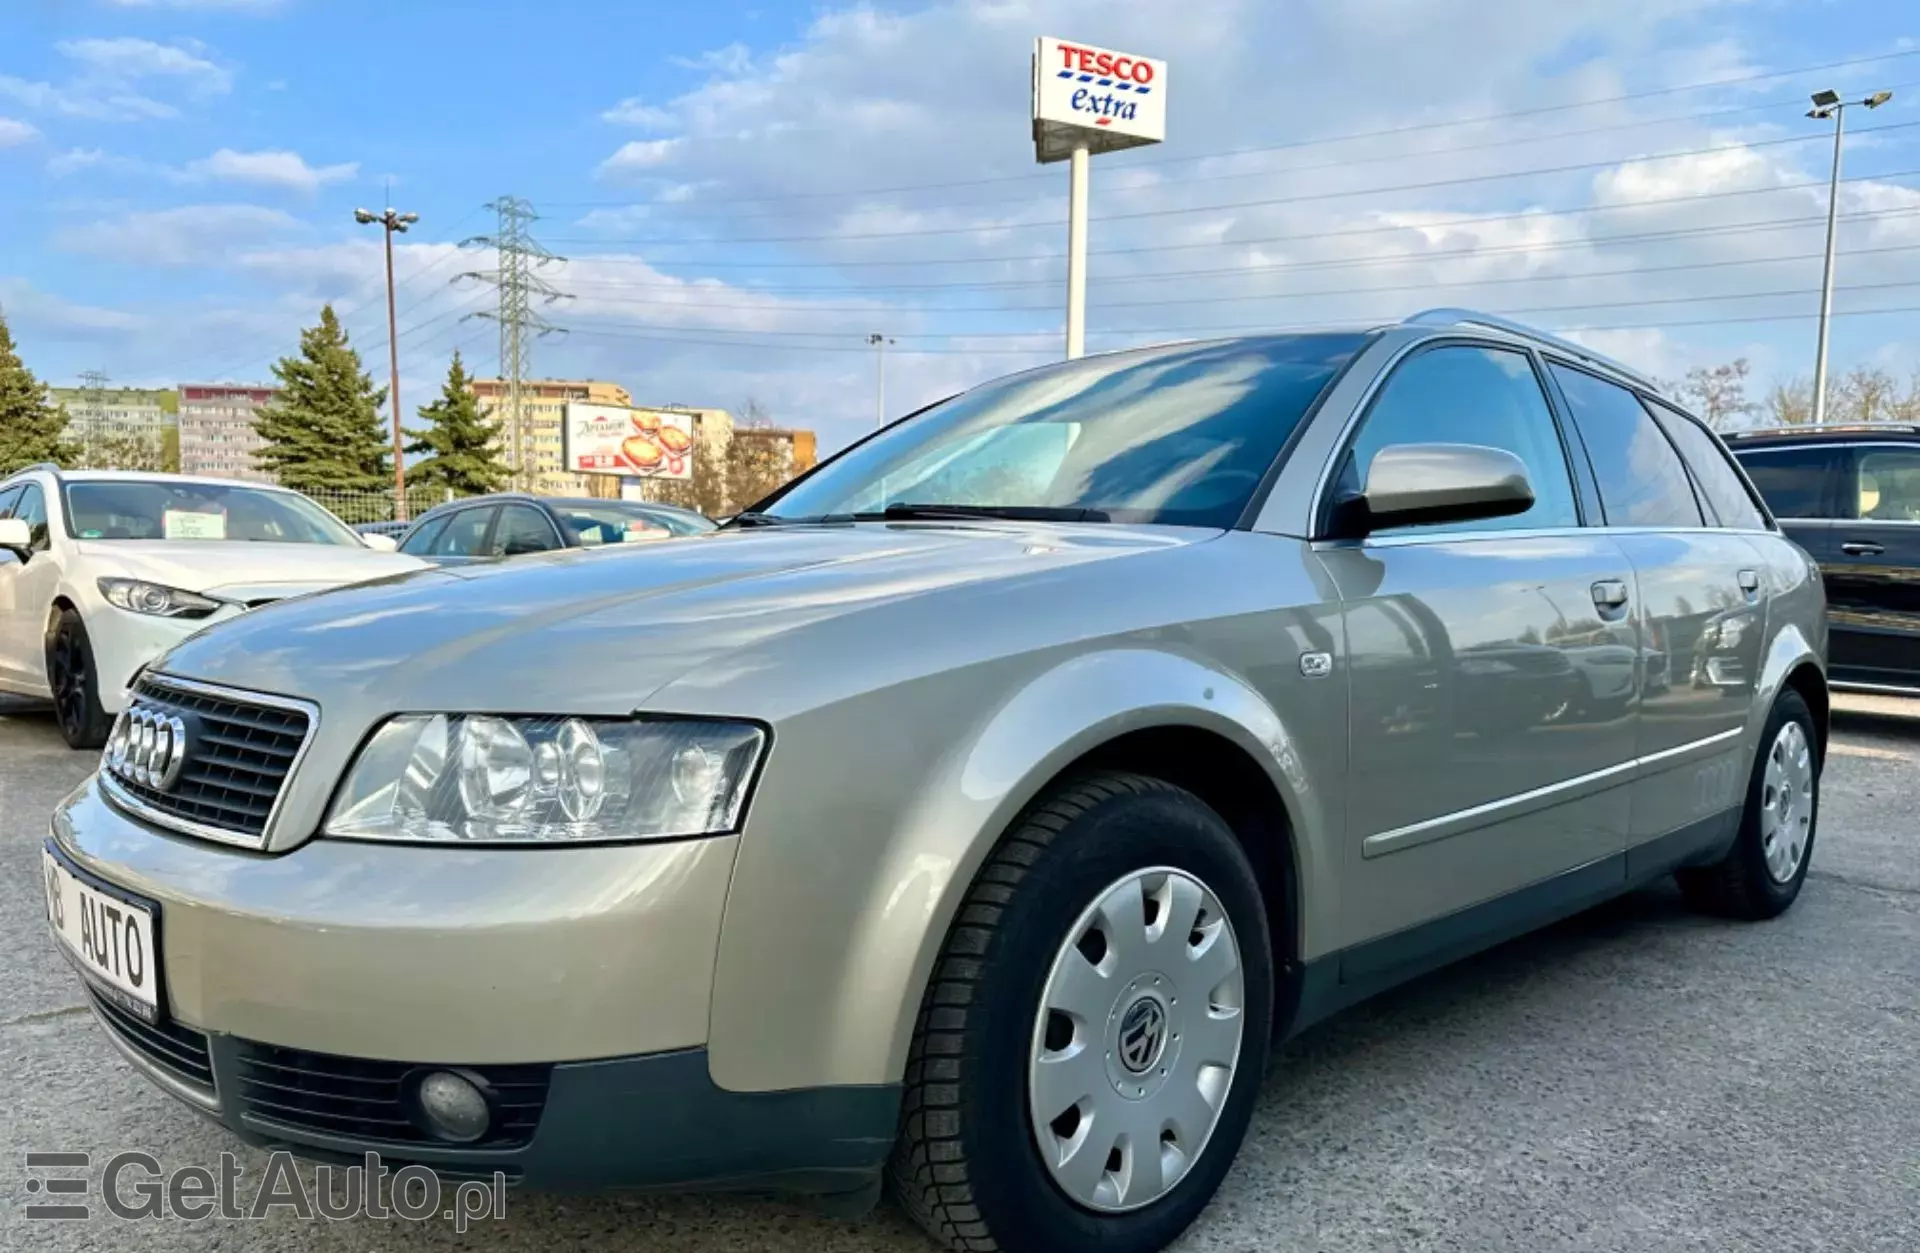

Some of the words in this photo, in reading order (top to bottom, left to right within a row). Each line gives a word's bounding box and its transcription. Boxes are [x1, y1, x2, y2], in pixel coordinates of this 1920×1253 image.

[1057, 44, 1153, 84] TESCO
[1071, 88, 1137, 120] extra
[80, 891, 143, 987] AUTO
